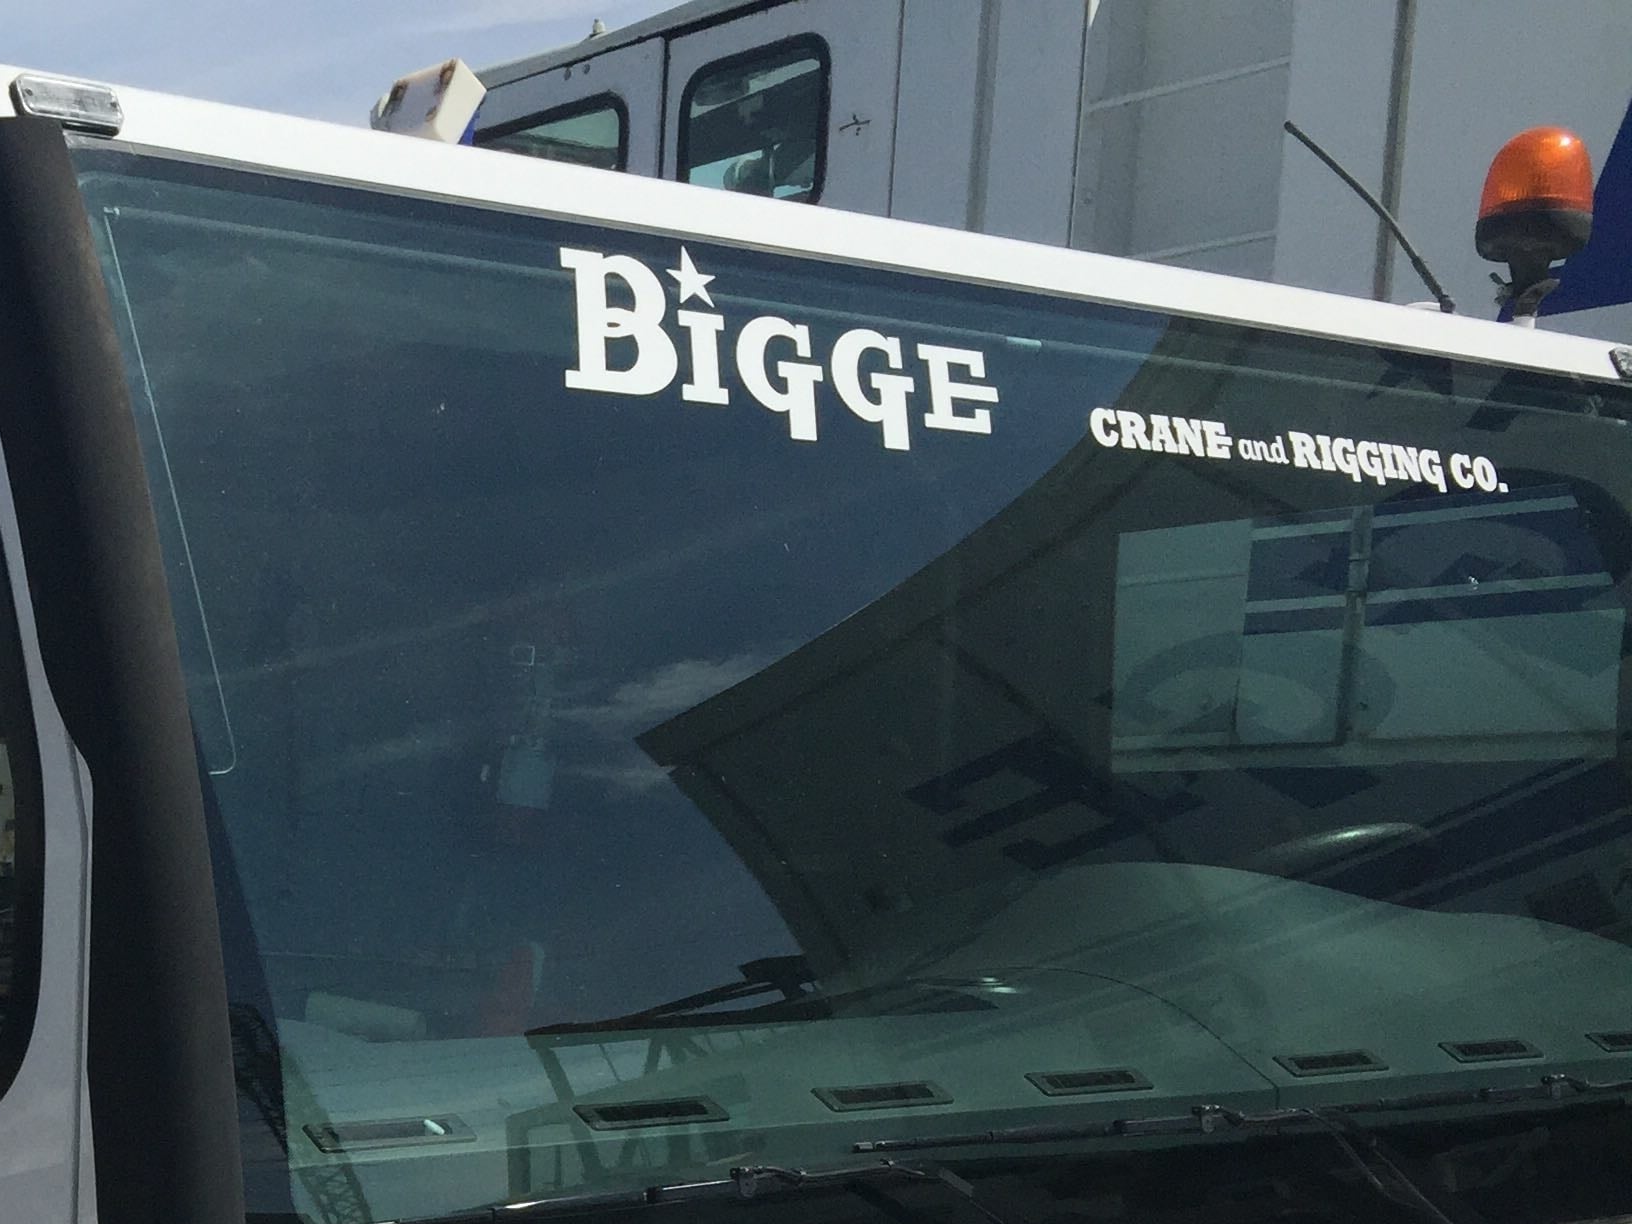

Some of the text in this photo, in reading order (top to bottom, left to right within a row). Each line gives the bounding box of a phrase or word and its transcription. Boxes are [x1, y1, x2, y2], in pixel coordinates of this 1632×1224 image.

[1090, 407, 1509, 494] CRANE and RIGGING CO.
